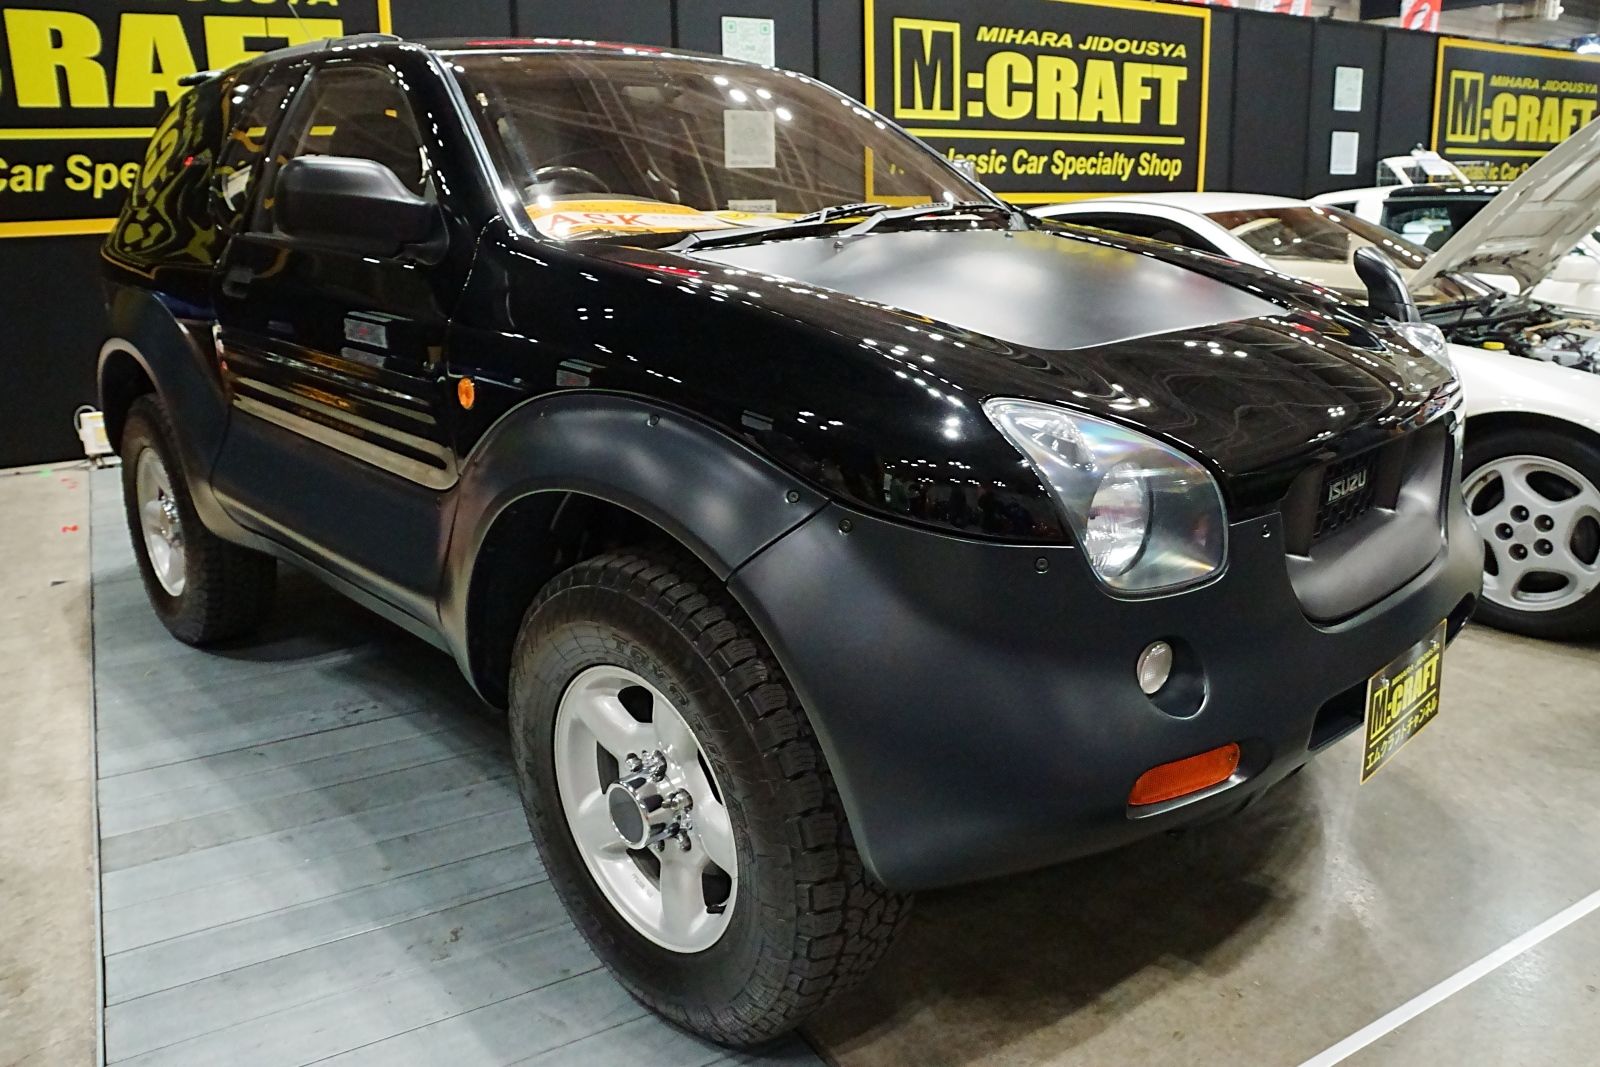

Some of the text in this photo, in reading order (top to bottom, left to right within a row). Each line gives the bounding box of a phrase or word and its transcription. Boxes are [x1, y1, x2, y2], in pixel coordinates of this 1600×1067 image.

[975, 26, 1188, 59] MIHARA JIDOUSYA
[1488, 74, 1599, 95] MIHARA JIDOUSYA
[1012, 149, 1049, 175] Car
[1050, 150, 1134, 182] Specialty
[1137, 153, 1182, 182] Shop
[549, 213, 648, 231] ASK
[1327, 468, 1368, 502] ISUZU
